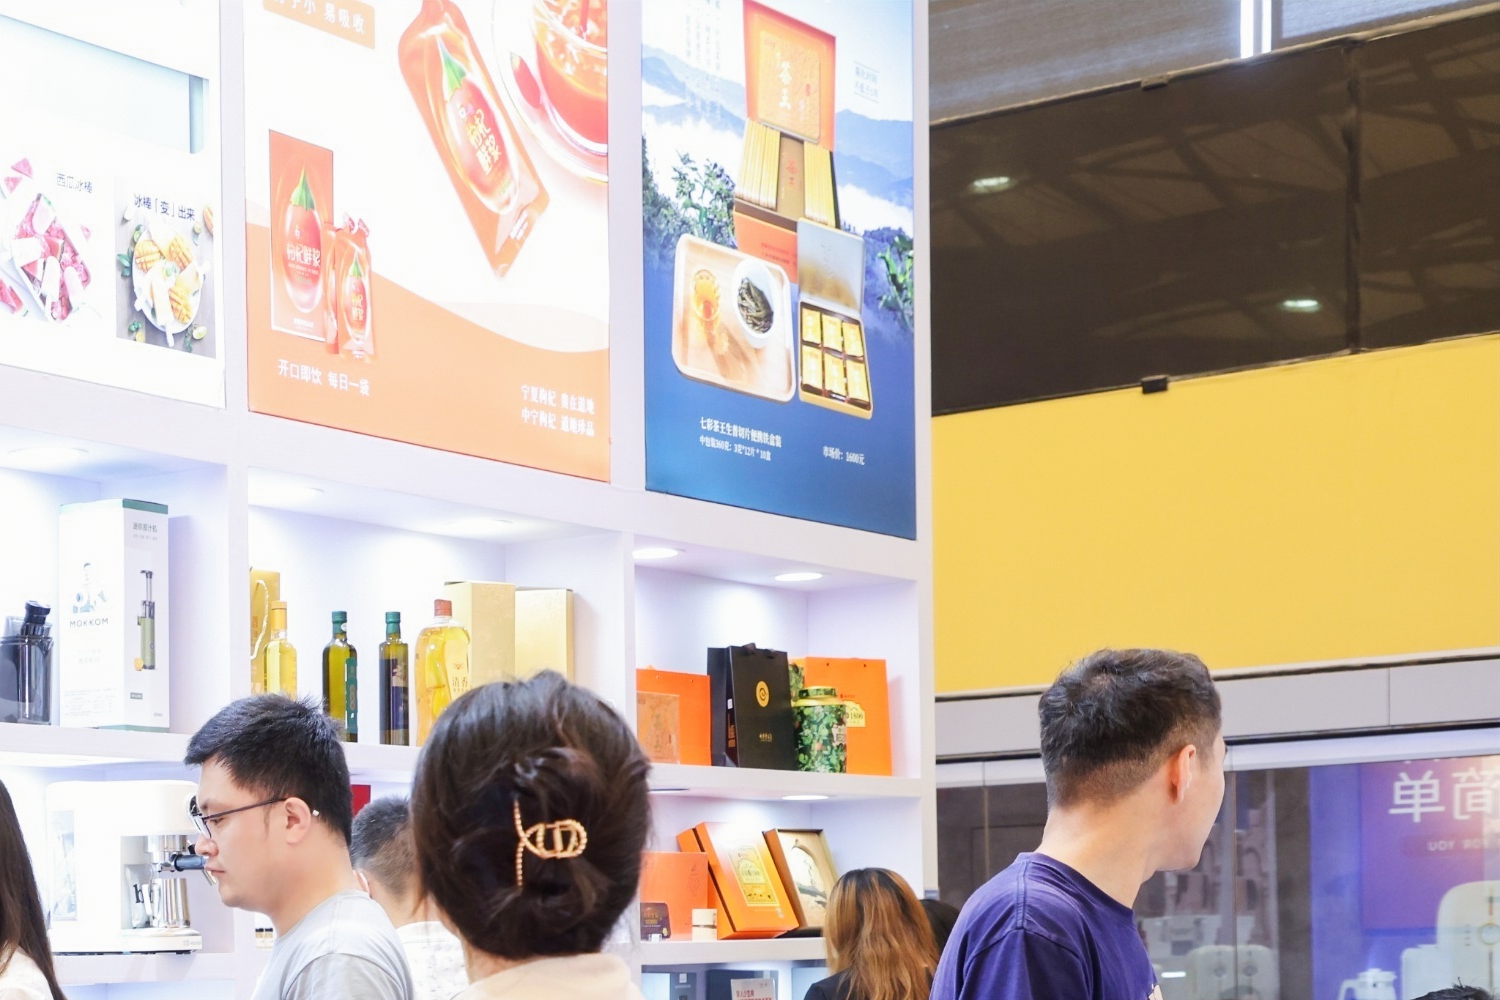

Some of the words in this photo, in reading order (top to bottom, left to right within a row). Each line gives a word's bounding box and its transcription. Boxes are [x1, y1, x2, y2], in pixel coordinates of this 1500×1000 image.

[278, 359, 322, 386] 开口即饮
[327, 371, 370, 396] 每日一袋
[521, 384, 557, 407] 宁夏枸杞
[521, 406, 557, 430] 中宁枸杞
[69, 617, 109, 628] MOKKOM
